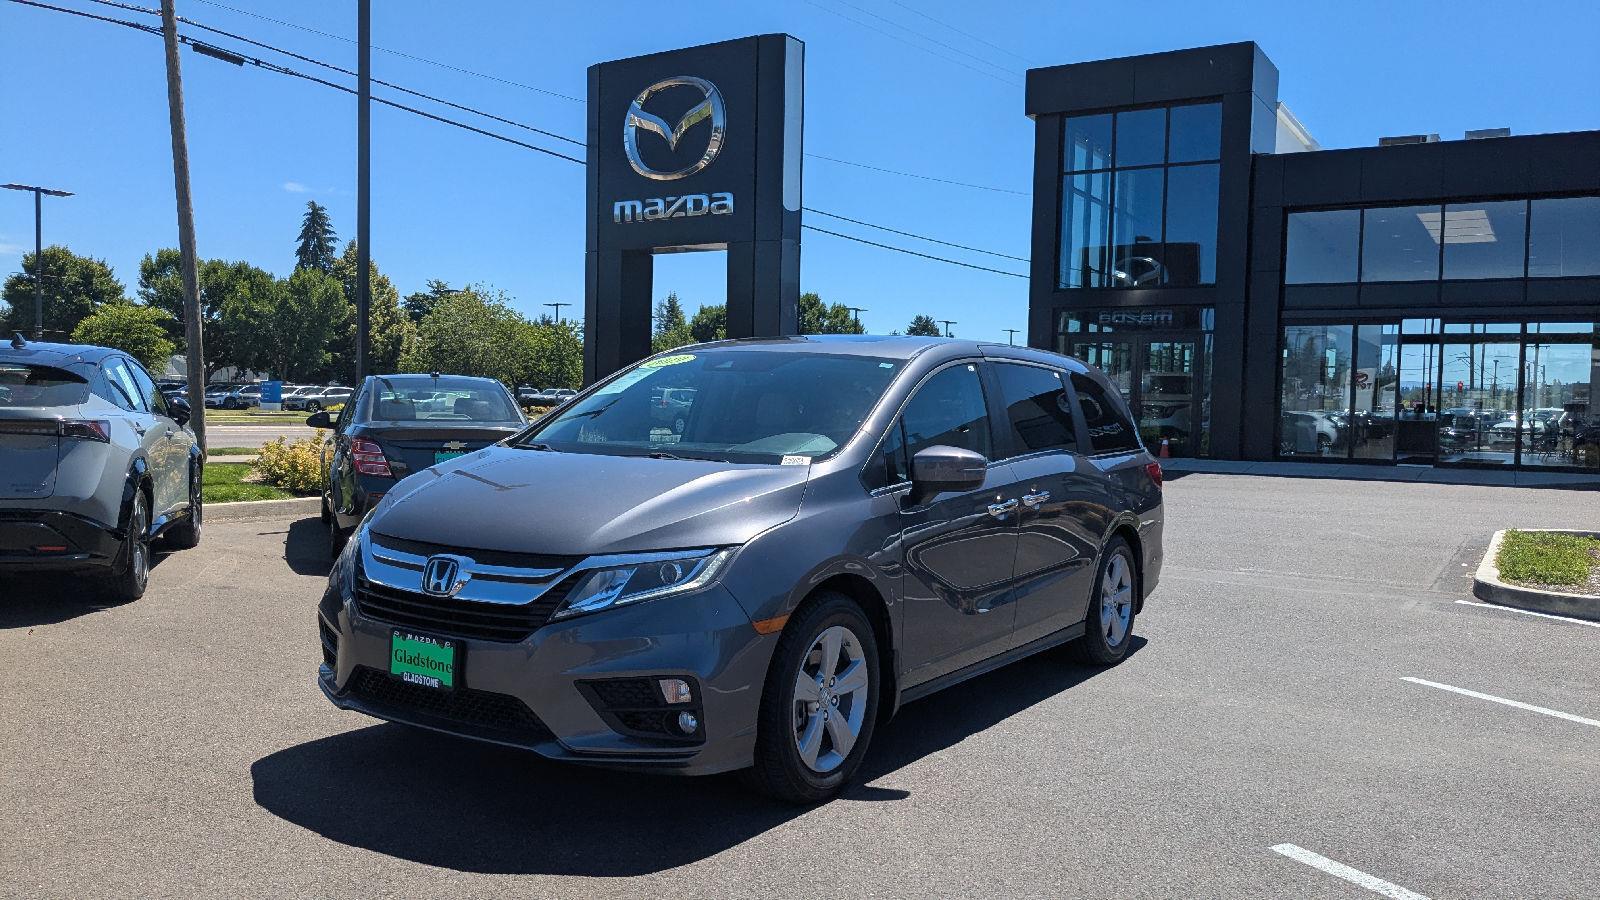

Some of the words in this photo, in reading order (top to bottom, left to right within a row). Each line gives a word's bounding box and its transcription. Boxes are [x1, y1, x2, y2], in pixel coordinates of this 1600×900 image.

[613, 191, 734, 223] mazda
[407, 633, 437, 646] MAZDA
[394, 648, 453, 674] Gladstone
[403, 671, 439, 688] GLADSTONE
